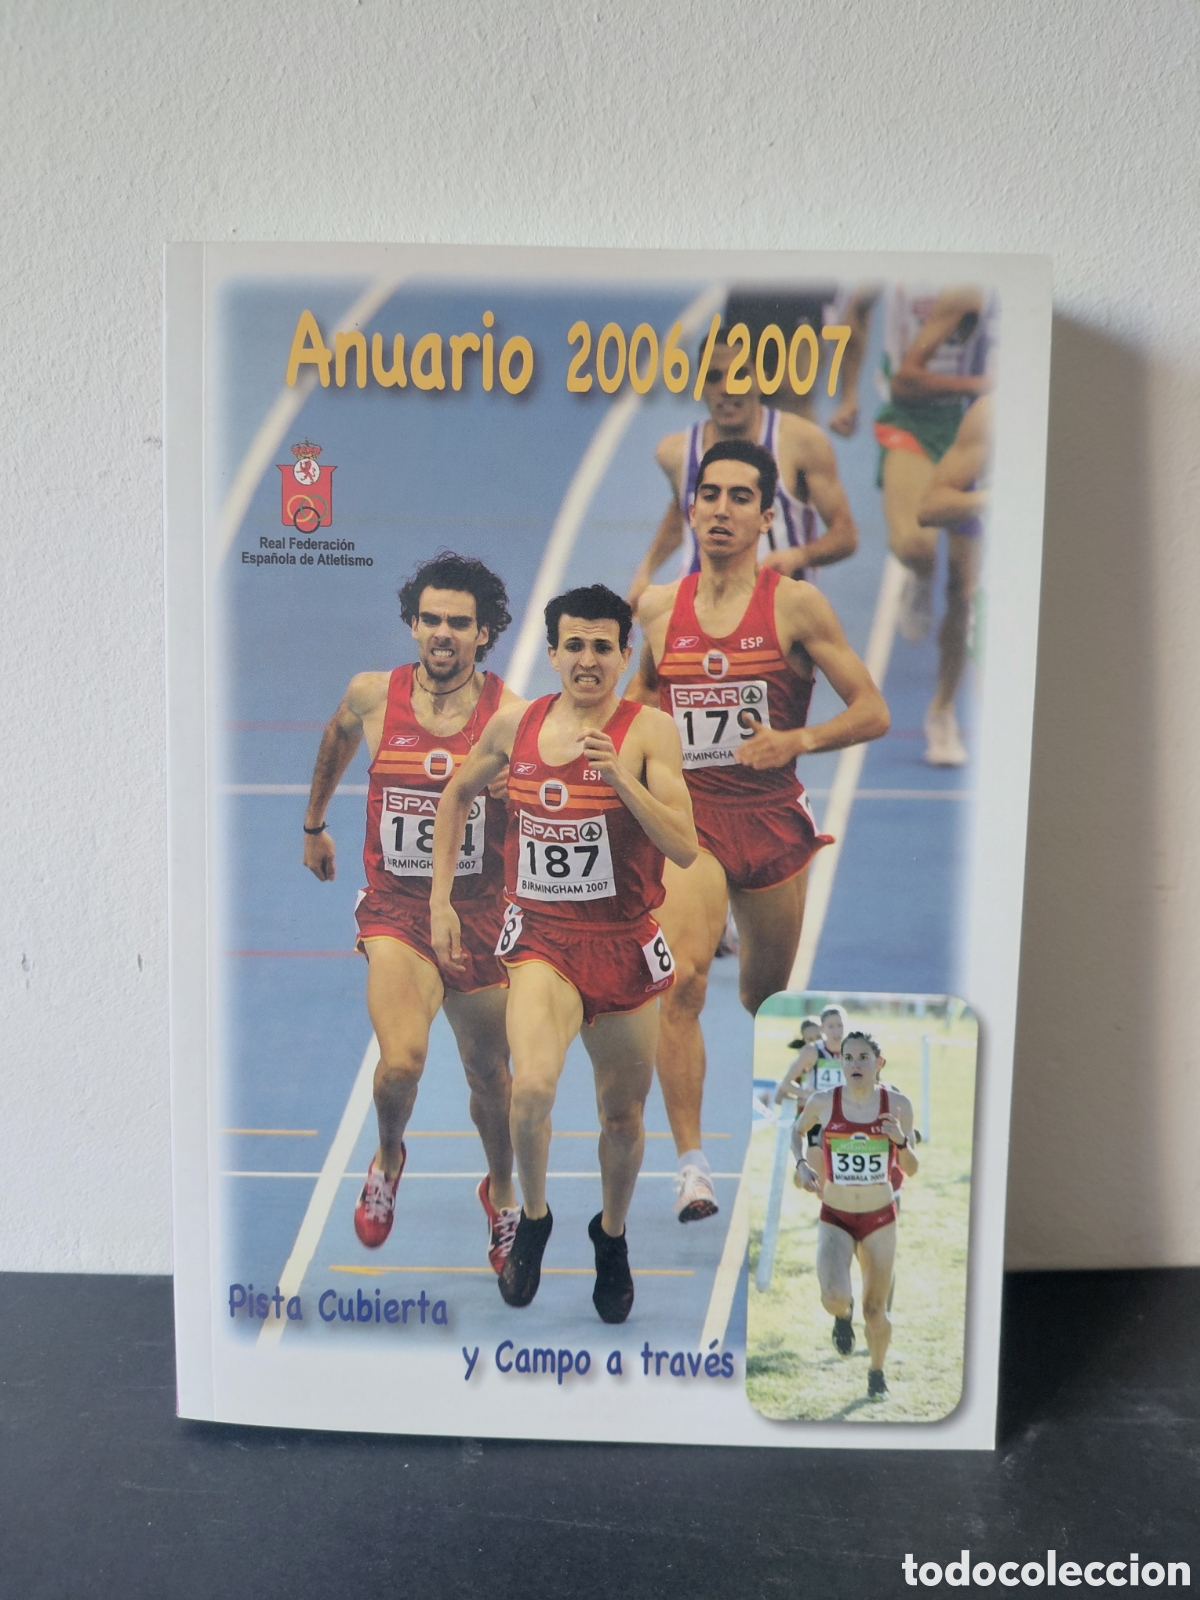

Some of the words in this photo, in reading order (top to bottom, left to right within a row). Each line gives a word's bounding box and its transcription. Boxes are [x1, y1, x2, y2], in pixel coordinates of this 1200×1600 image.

[286, 309, 534, 395] Anuario
[566, 313, 852, 402] 2006/2007
[259, 536, 286, 550] Real
[289, 537, 355, 551] Federación
[241, 551, 296, 567] Española
[299, 553, 314, 565] de
[317, 553, 374, 567] Atletismo
[740, 636, 764, 650] ESP
[675, 688, 739, 706] SPAR
[682, 706, 763, 746] 179
[682, 750, 734, 762] IRMINGHA
[388, 794, 437, 815] SPA
[522, 819, 578, 841] SPAR
[526, 840, 600, 879] 187
[521, 879, 584, 895] BIRMINGHAM
[586, 881, 609, 892] 2007
[499, 916, 517, 952] 8
[653, 936, 672, 972] 8
[836, 1152, 882, 1173] 395
[228, 1282, 303, 1321] Pista
[318, 1287, 449, 1326] Cubierta
[461, 1345, 480, 1382] y
[495, 1340, 592, 1386] Campo
[605, 1350, 623, 1376] a
[640, 1338, 735, 1379] través
